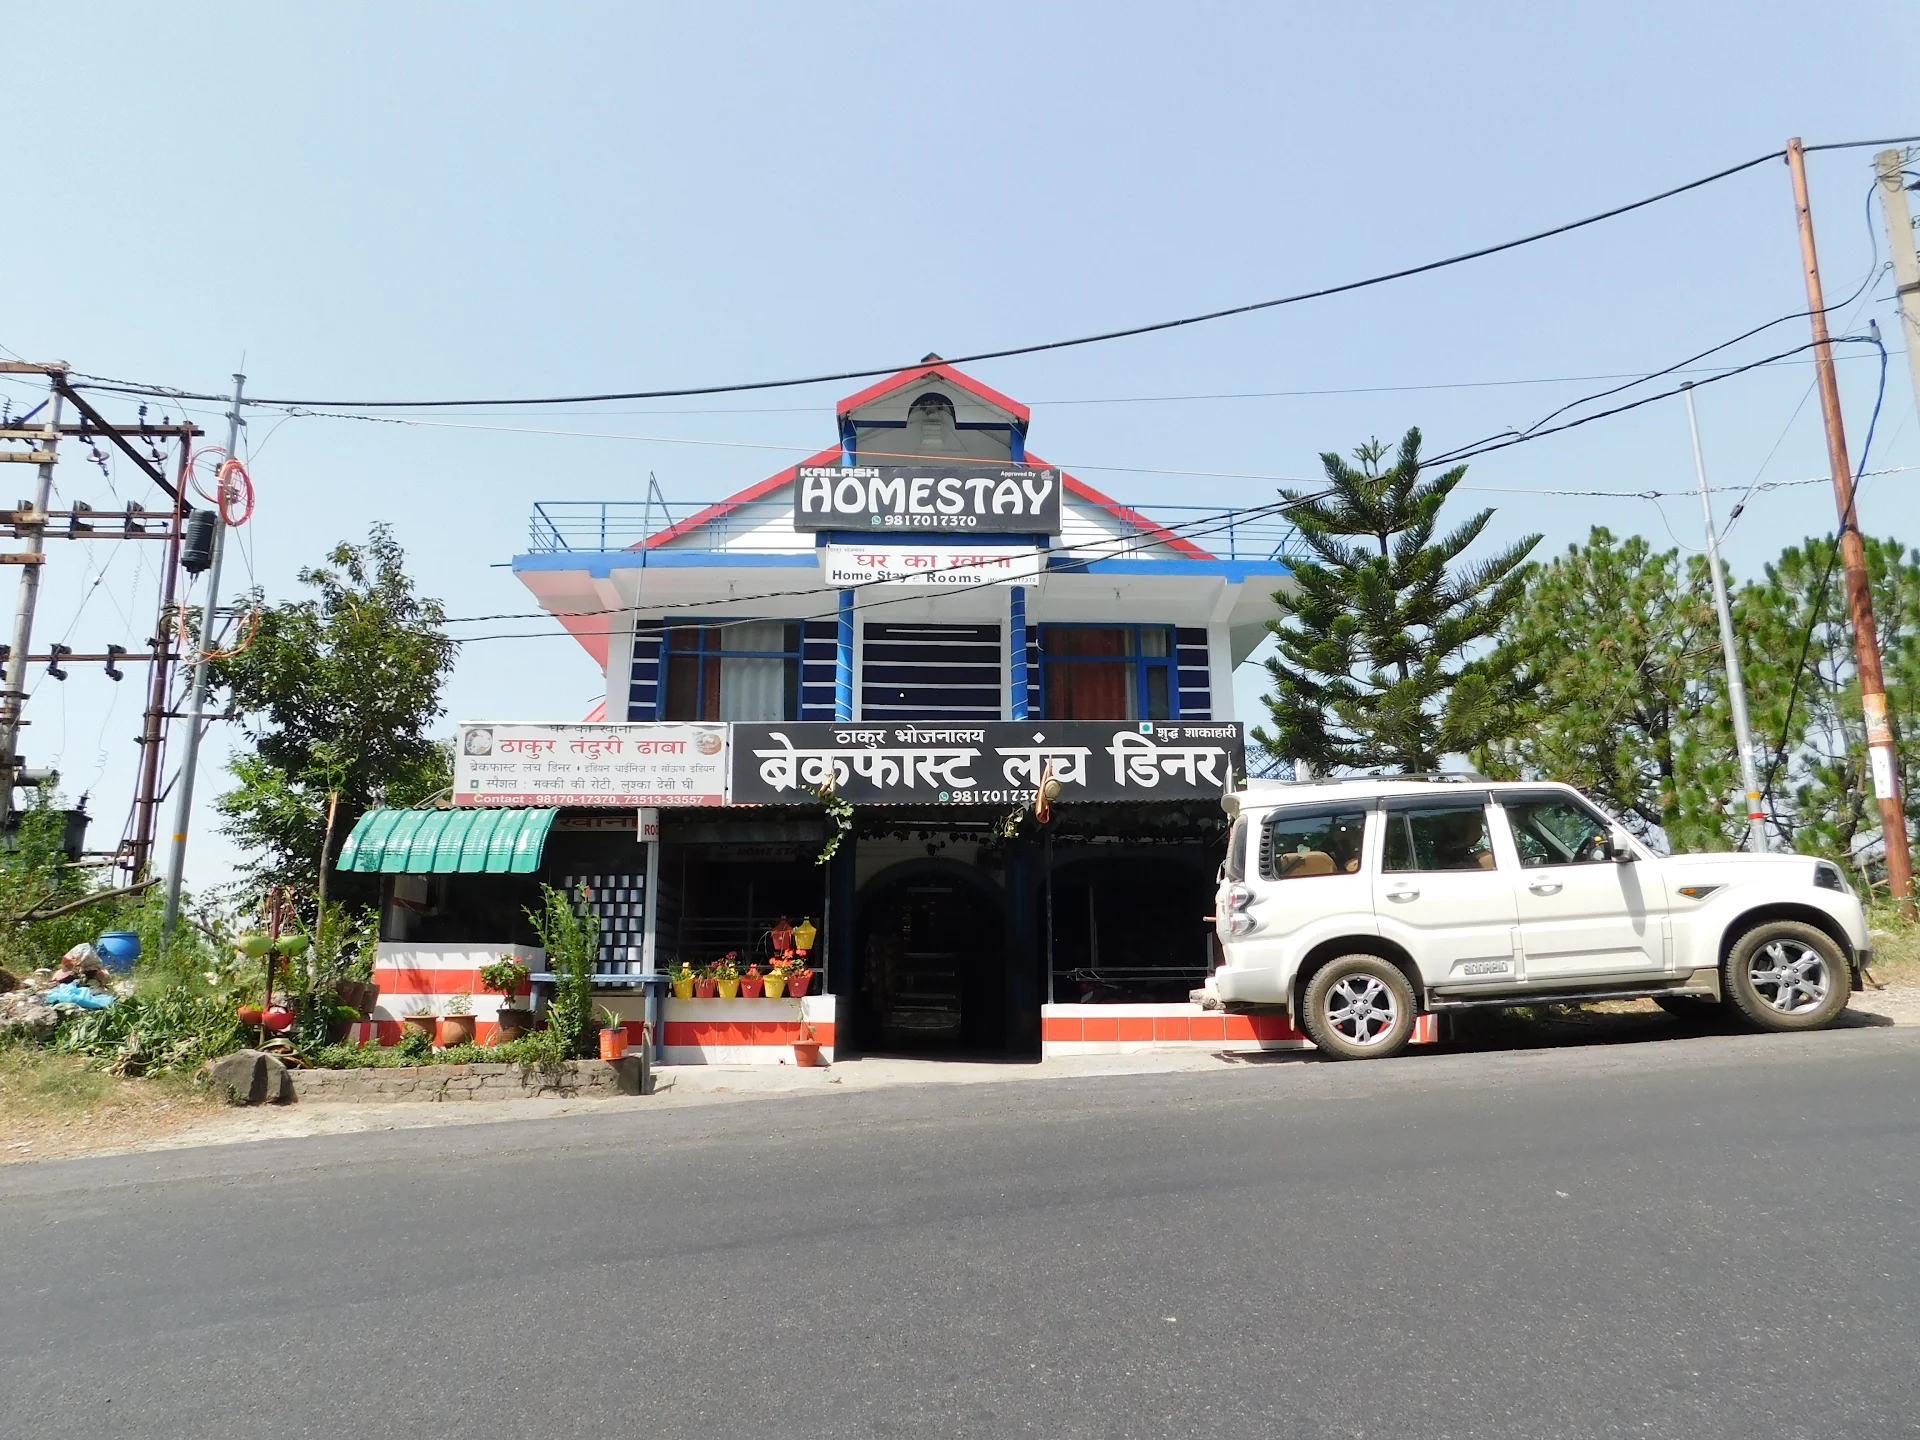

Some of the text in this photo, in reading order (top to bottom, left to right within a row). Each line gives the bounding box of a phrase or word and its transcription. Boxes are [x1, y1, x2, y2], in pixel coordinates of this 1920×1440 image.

[800, 467, 879, 477] KAILASH
[801, 477, 1052, 514] HOMESTAY
[884, 515, 977, 526] 9817017370
[853, 554, 1011, 569] घर का खाना
[832, 570, 872, 580] Home
[877, 570, 908, 583] Stay
[926, 572, 982, 583] Rooms
[548, 724, 633, 734] घर का खाना
[1156, 724, 1237, 742] शुद्ध शाकाहारी
[834, 725, 985, 749] ठाकुर भोजनालय
[498, 735, 687, 760] ठाकुर तंदुरी ढाबा
[548, 760, 571, 773] डिनर
[752, 731, 1225, 792] ब्रेकफास्ट लंच डिनर
[532, 777, 565, 789] मक्की
[570, 777, 586, 789] की
[656, 776, 676, 790] देसी
[681, 777, 694, 790] घी
[473, 794, 525, 803] Contact
[624, 796, 704, 804] 73513-33557
[952, 790, 1039, 802] 981701737
